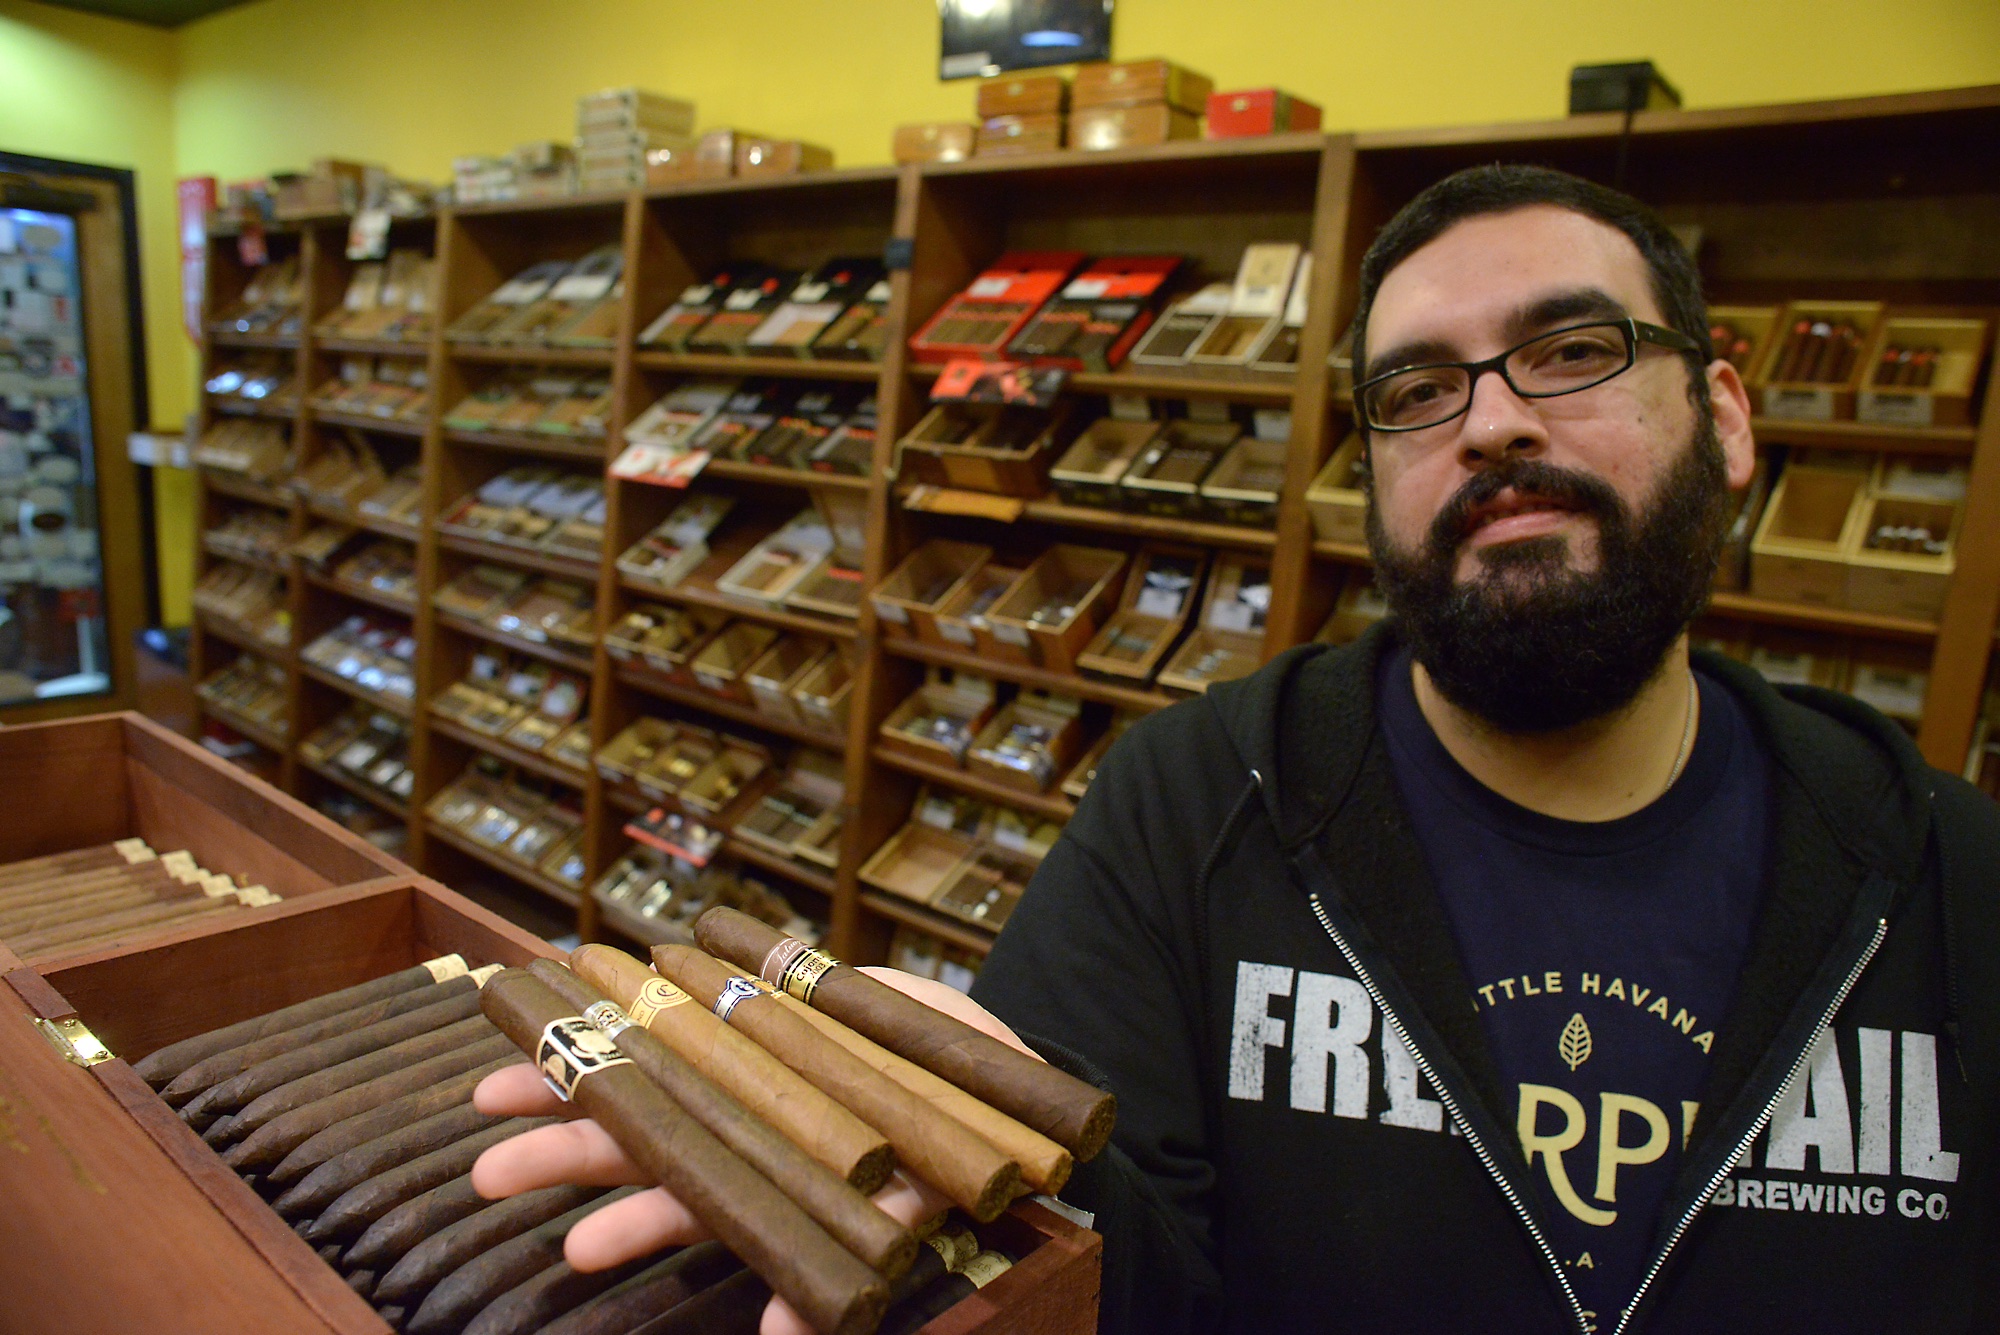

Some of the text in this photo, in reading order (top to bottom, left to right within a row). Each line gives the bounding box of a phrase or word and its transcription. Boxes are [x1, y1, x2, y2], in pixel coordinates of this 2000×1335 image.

[1470, 971, 1715, 1054] TTLE HAVANA
[1735, 1026, 1960, 1182] AIL
[1711, 1178, 1886, 1215] BREWING
